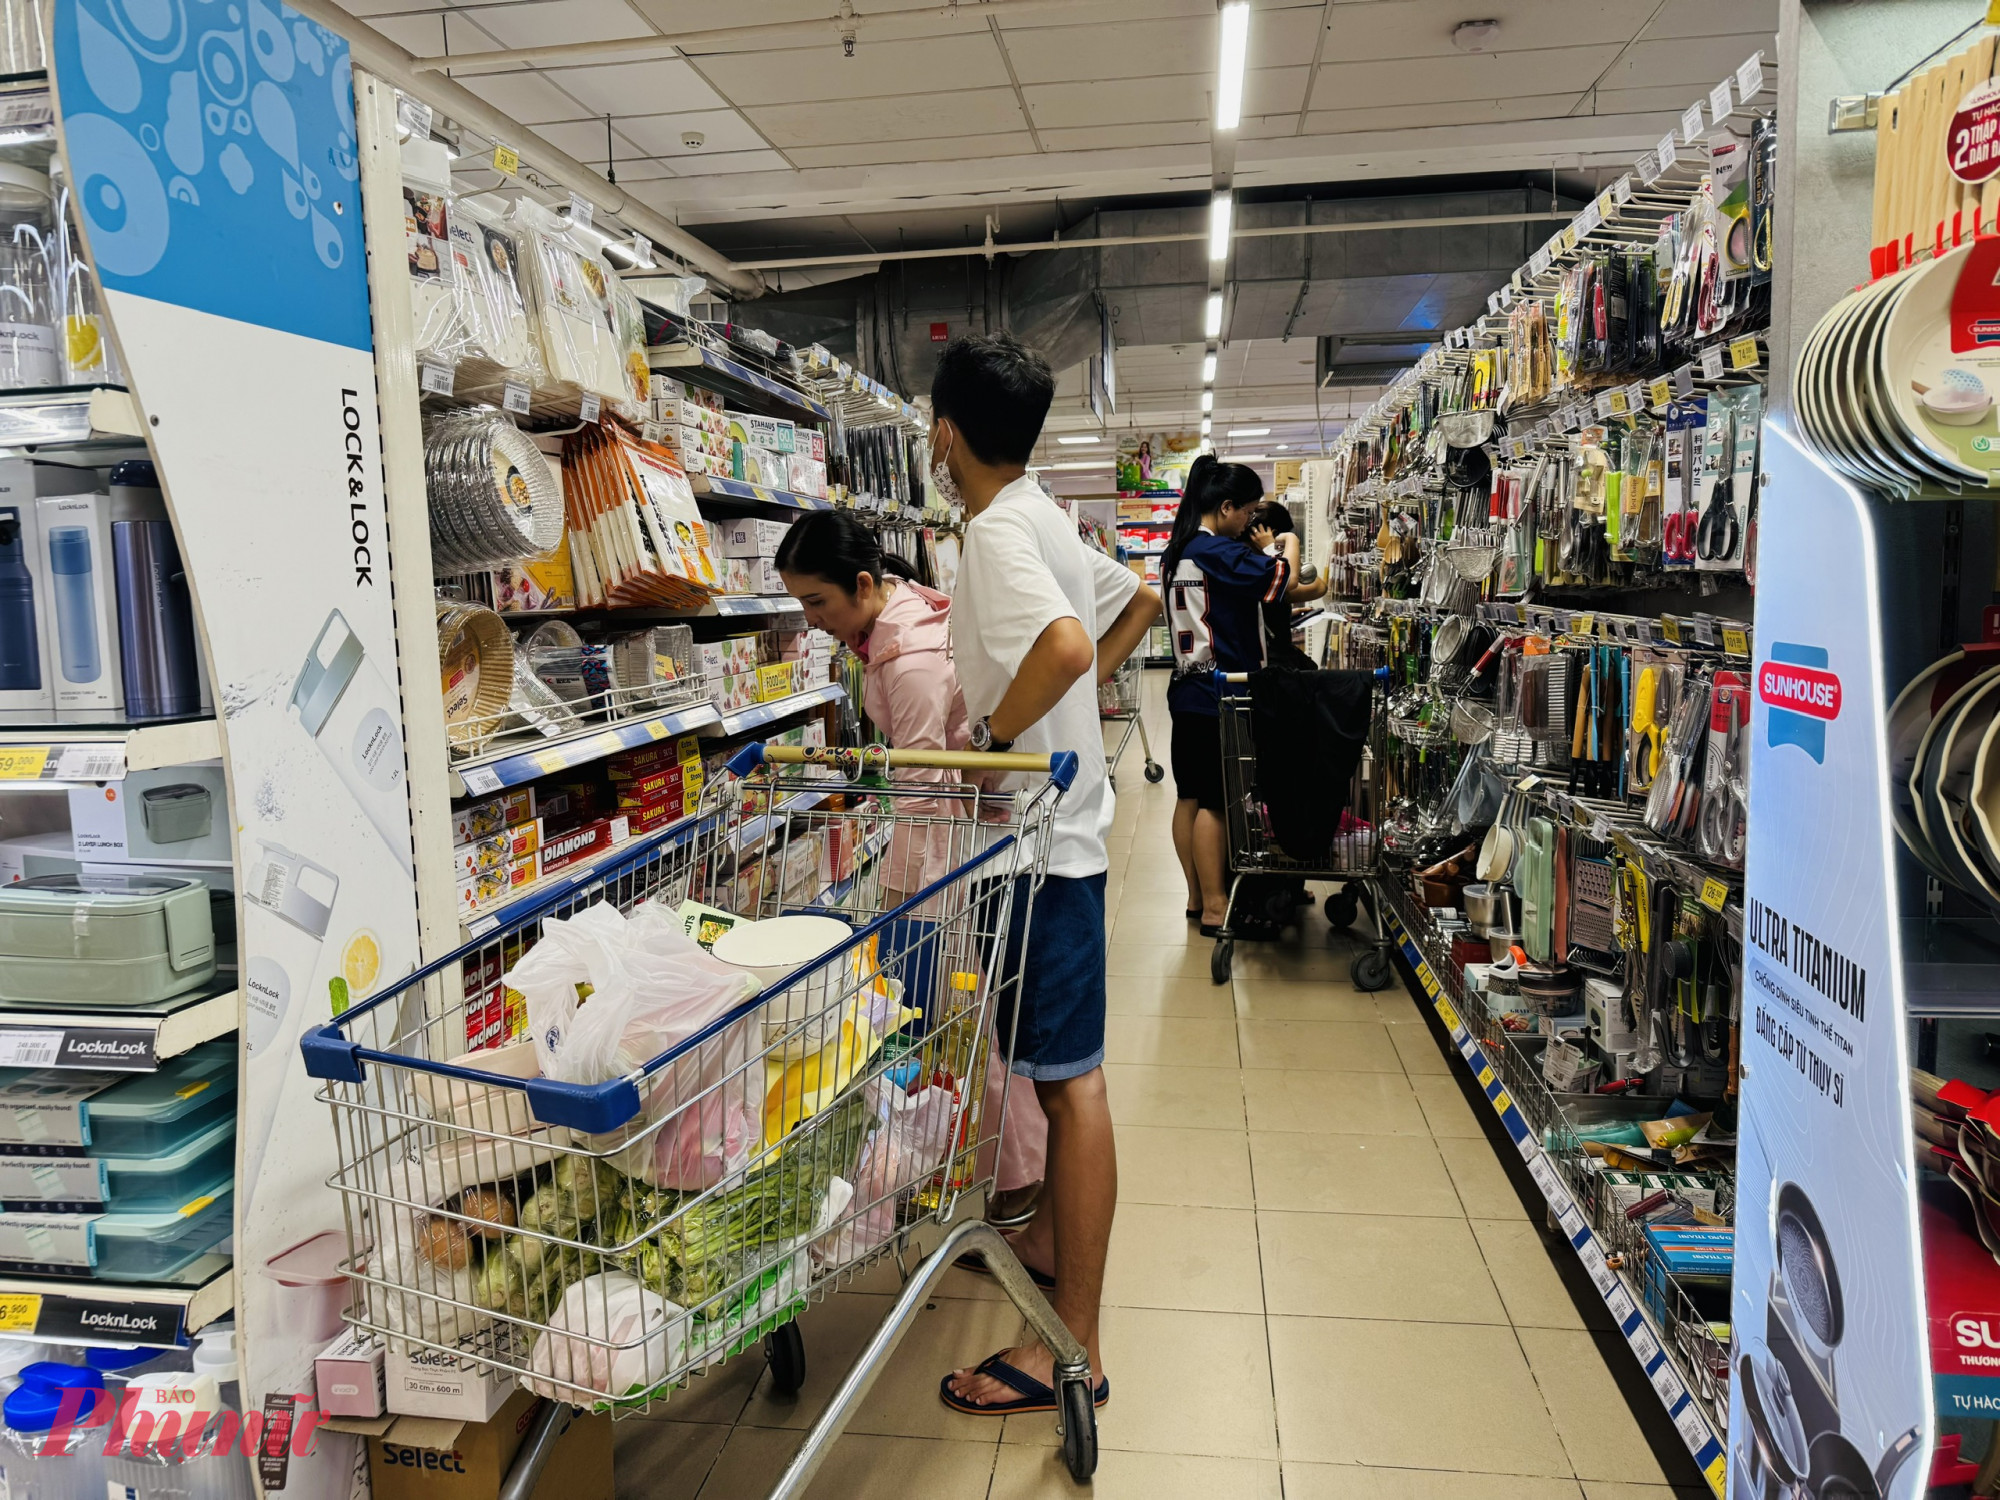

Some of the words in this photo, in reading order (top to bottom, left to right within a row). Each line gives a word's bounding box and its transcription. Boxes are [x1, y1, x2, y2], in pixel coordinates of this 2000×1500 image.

[1954, 129, 1970, 170] 2
[1716, 164, 1733, 175] NEW
[341, 388, 364, 474] LOCK
[750, 419, 776, 432] STAHAUS
[796, 430, 810, 440] TAHAUS
[348, 477, 363, 498] &
[351, 503, 373, 588] LOCK
[1764, 672, 1834, 708] SUNHOUSE
[362, 725, 383, 760] LocknLock
[633, 751, 658, 766] SAKURA
[686, 765, 697, 774] Extra
[643, 776, 666, 793] SAKURA
[686, 790, 697, 799] Extra
[642, 803, 666, 821] SAKURA
[544, 830, 596, 862] DIAMOND
[1750, 897, 1788, 967] ULTRA
[1793, 924, 1866, 1023] TITANIUM
[248, 977, 280, 1000] LocknLock
[1755, 969, 1776, 996] CHỐNG
[1776, 984, 1790, 1007] DÍNH
[1791, 997, 1804, 1018] SIÊU
[1805, 1009, 1819, 1031] TINH
[1820, 1020, 1833, 1042] THỂ
[1833, 1031, 1854, 1057] TITAN
[468, 1020, 500, 1050] MOND
[67, 1039, 148, 1055] LocknLock
[1778, 1022, 1794, 1062] CẤP
[1796, 1039, 1807, 1075] TỪ
[1809, 1050, 1831, 1097] THỤY
[80, 1310, 157, 1330] LocknLock
[409, 1381, 418, 1389] 30
[436, 1385, 451, 1393] 600
[1953, 1394, 1971, 1411] TỰ
[383, 1444, 466, 1473] Select
